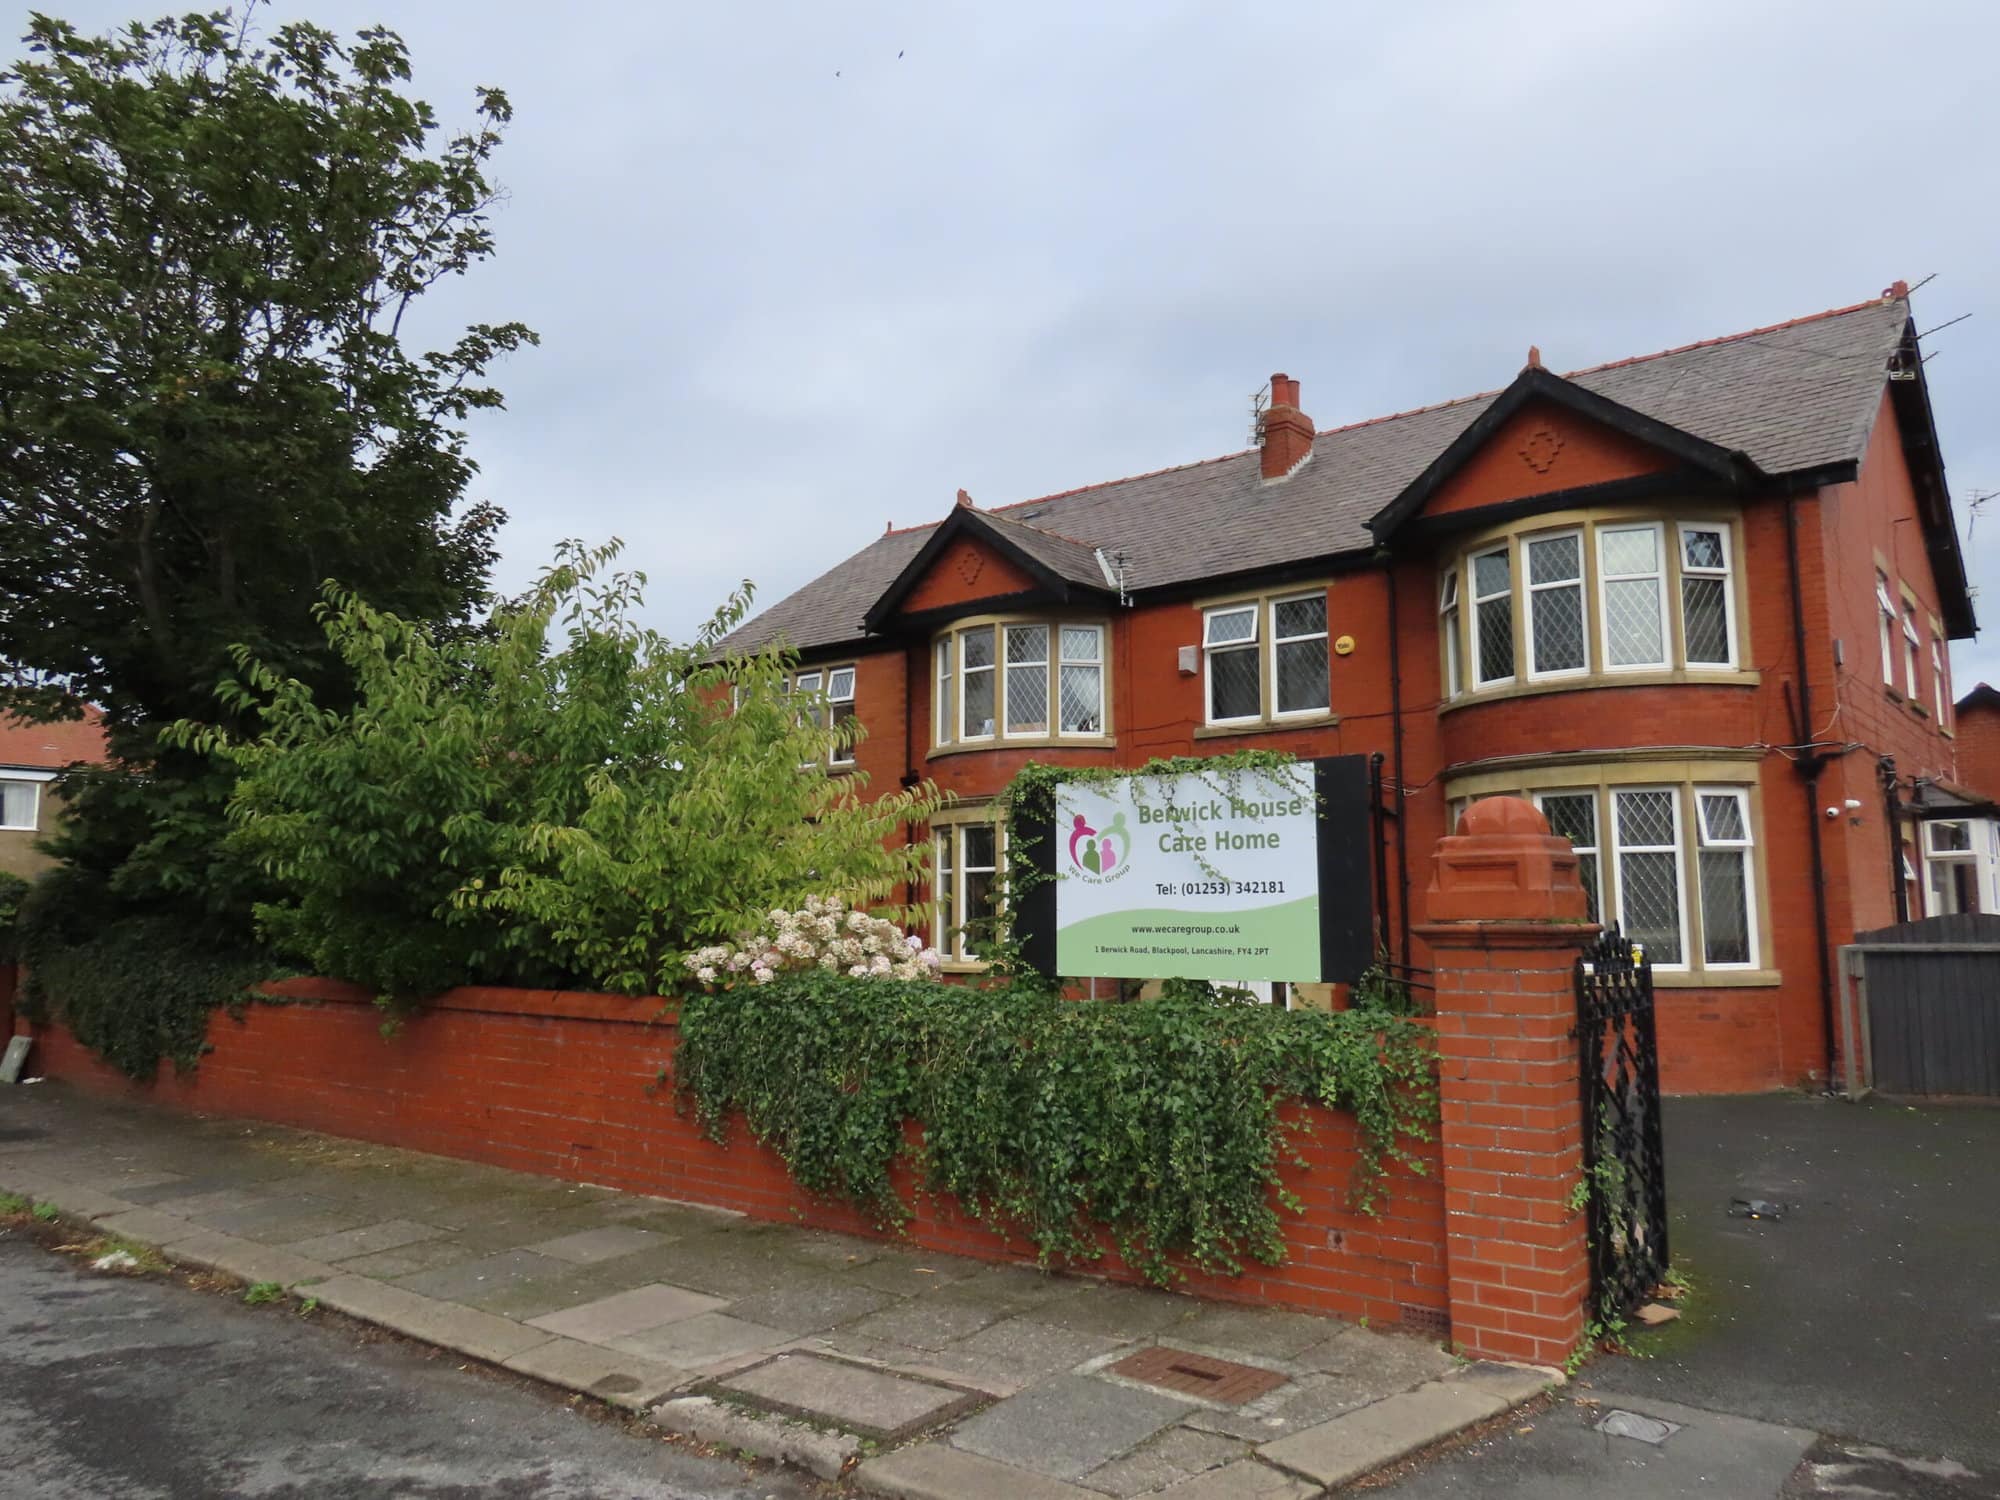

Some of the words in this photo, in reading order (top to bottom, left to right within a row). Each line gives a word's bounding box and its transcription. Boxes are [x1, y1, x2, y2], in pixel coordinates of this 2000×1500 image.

[1138, 800, 1223, 825] Berwick
[1230, 799, 1302, 819] House
[1158, 833, 1207, 853] Care
[1215, 830, 1280, 851] Home
[1068, 864, 1081, 879] We
[1082, 874, 1102, 885] Care
[1104, 864, 1130, 884] Group
[1155, 883, 1177, 895] Tel:
[1181, 881, 1231, 897] (01253)
[1235, 880, 1285, 894] 342181
[1131, 923, 1241, 936] www.wecaregroup.co.uk
[1095, 945, 1100, 953] 1
[1100, 945, 1128, 954] Berwick
[1129, 945, 1150, 955] Road,
[1151, 946, 1190, 956] Blackpool,
[1191, 946, 1235, 956] Lancashire,
[1237, 946, 1252, 955] FY4
[1254, 947, 1269, 956] 2PT
